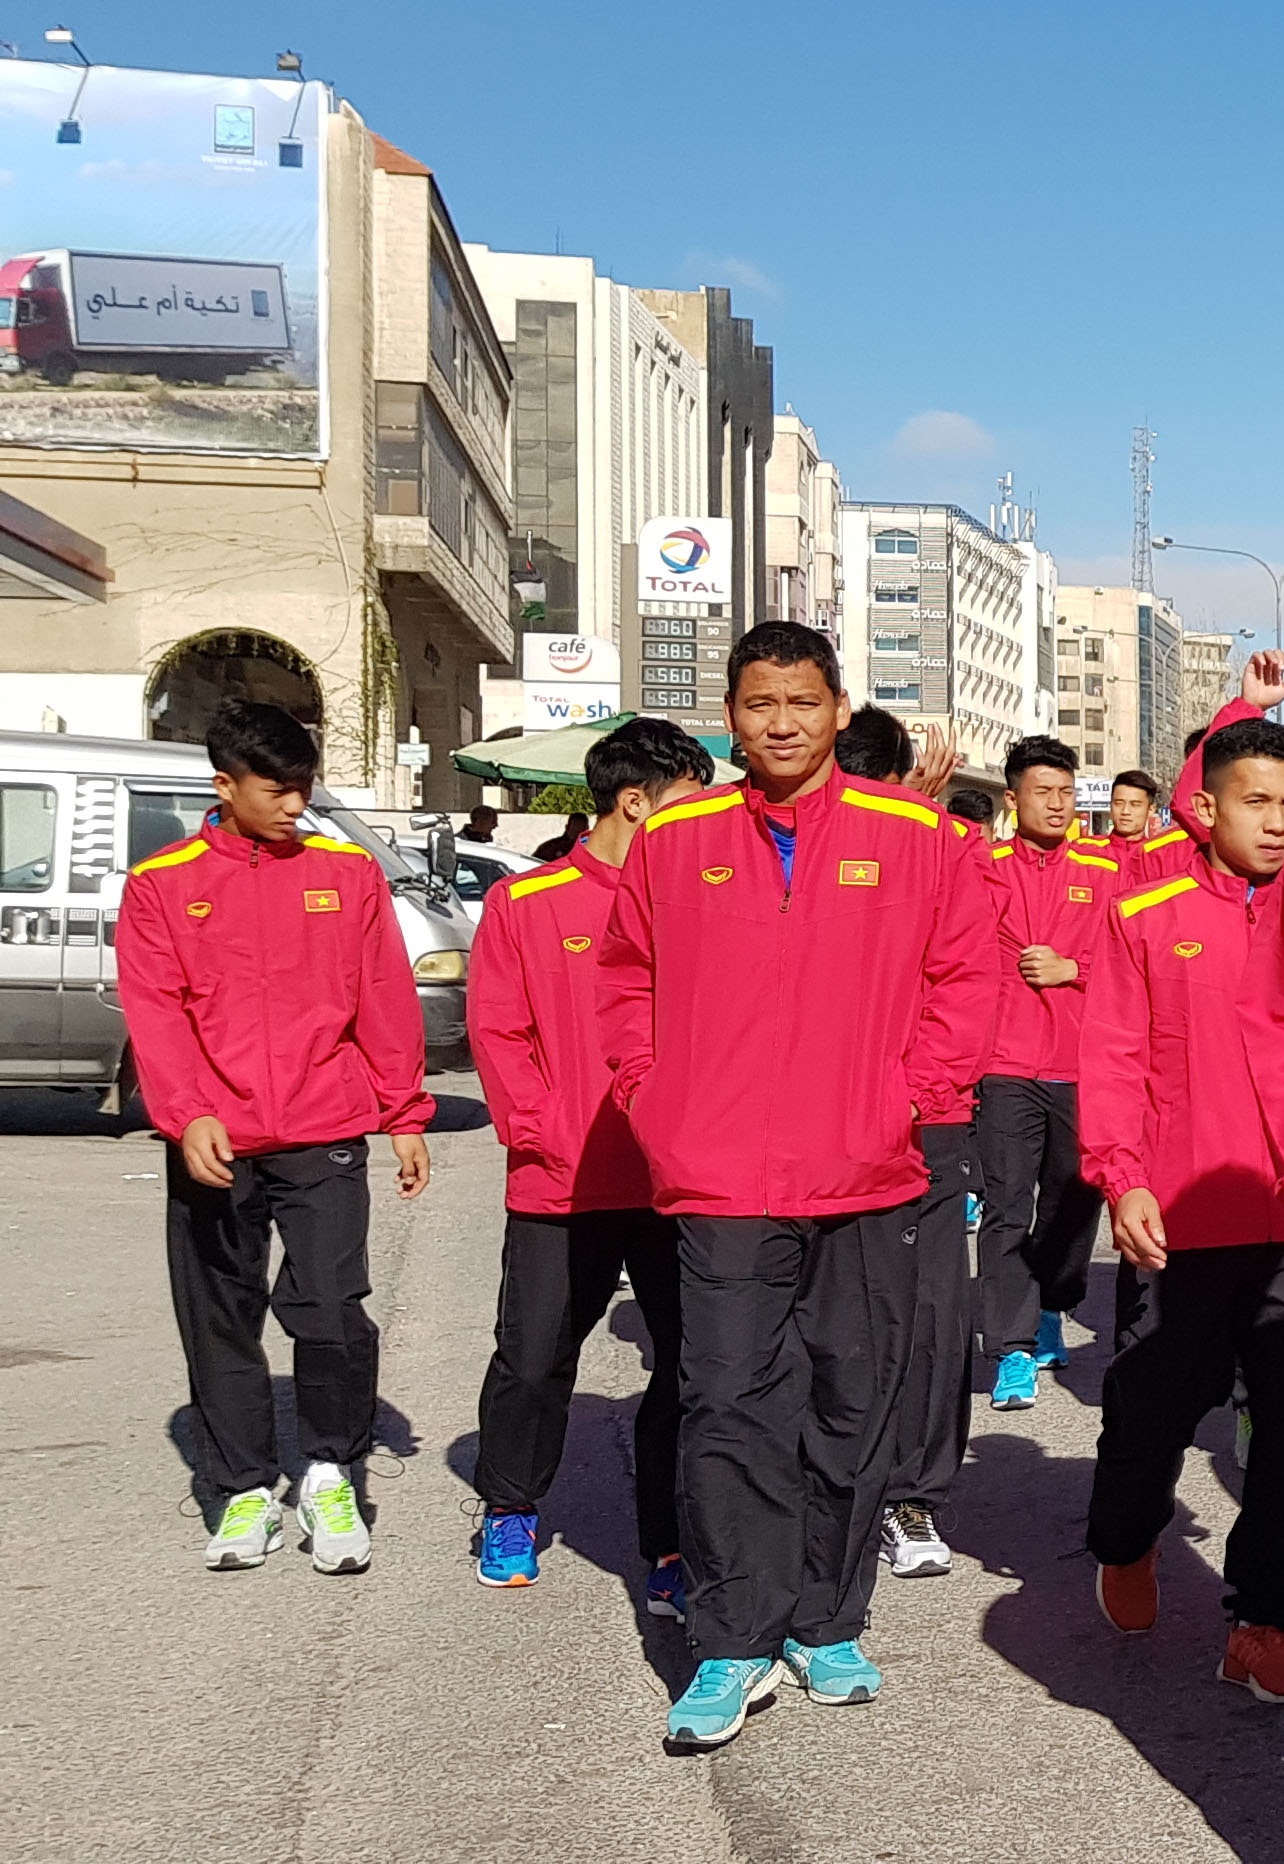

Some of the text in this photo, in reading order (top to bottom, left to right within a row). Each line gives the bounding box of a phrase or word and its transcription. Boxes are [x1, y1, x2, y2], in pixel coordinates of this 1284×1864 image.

[86, 284, 240, 320] تكية أم علي
[548, 638, 586, 653] café
[707, 651, 719, 659] 95
[547, 699, 612, 718] wash
